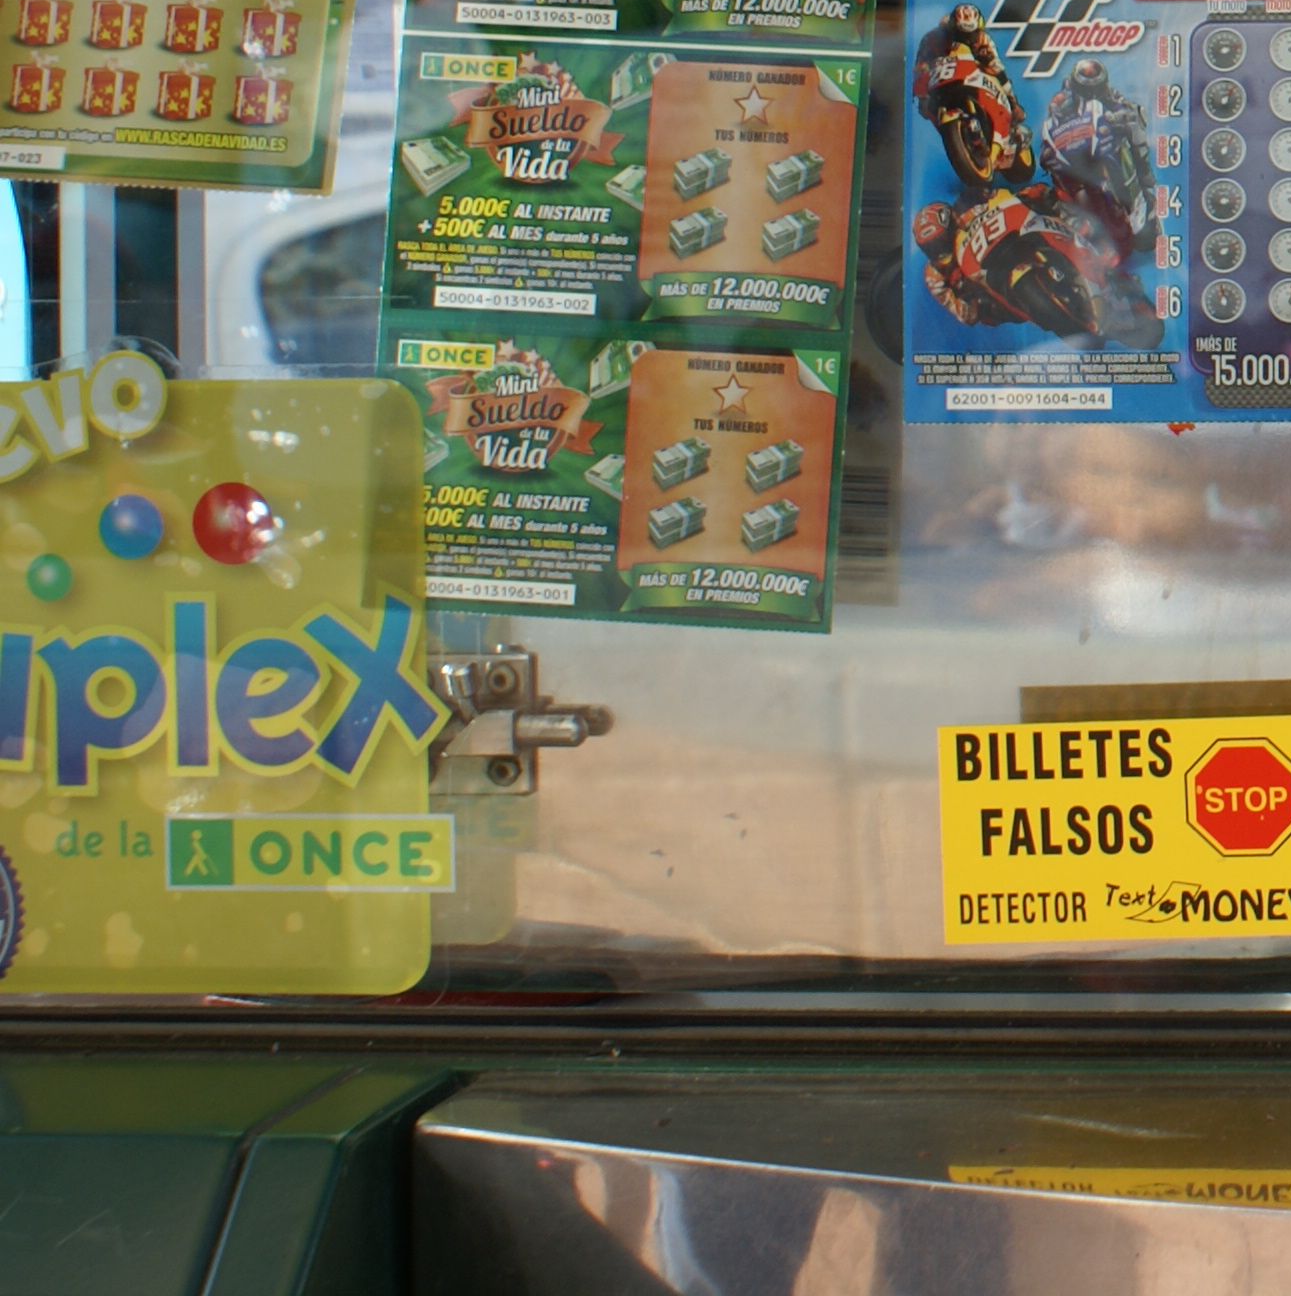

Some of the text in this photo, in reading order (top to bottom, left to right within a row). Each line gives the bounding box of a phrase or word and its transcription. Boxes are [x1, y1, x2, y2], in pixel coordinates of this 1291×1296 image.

[448, 60, 509, 77] ONCE
[426, 347, 488, 364] ONCE
[953, 392, 1105, 406] 62001-0091604-044
[955, 727, 1172, 782] BILLETES
[1204, 786, 1287, 813] STOP
[981, 804, 1154, 857] FALSOS
[56, 820, 433, 876] de la ONCE
[960, 892, 1087, 925] DETECTOR
